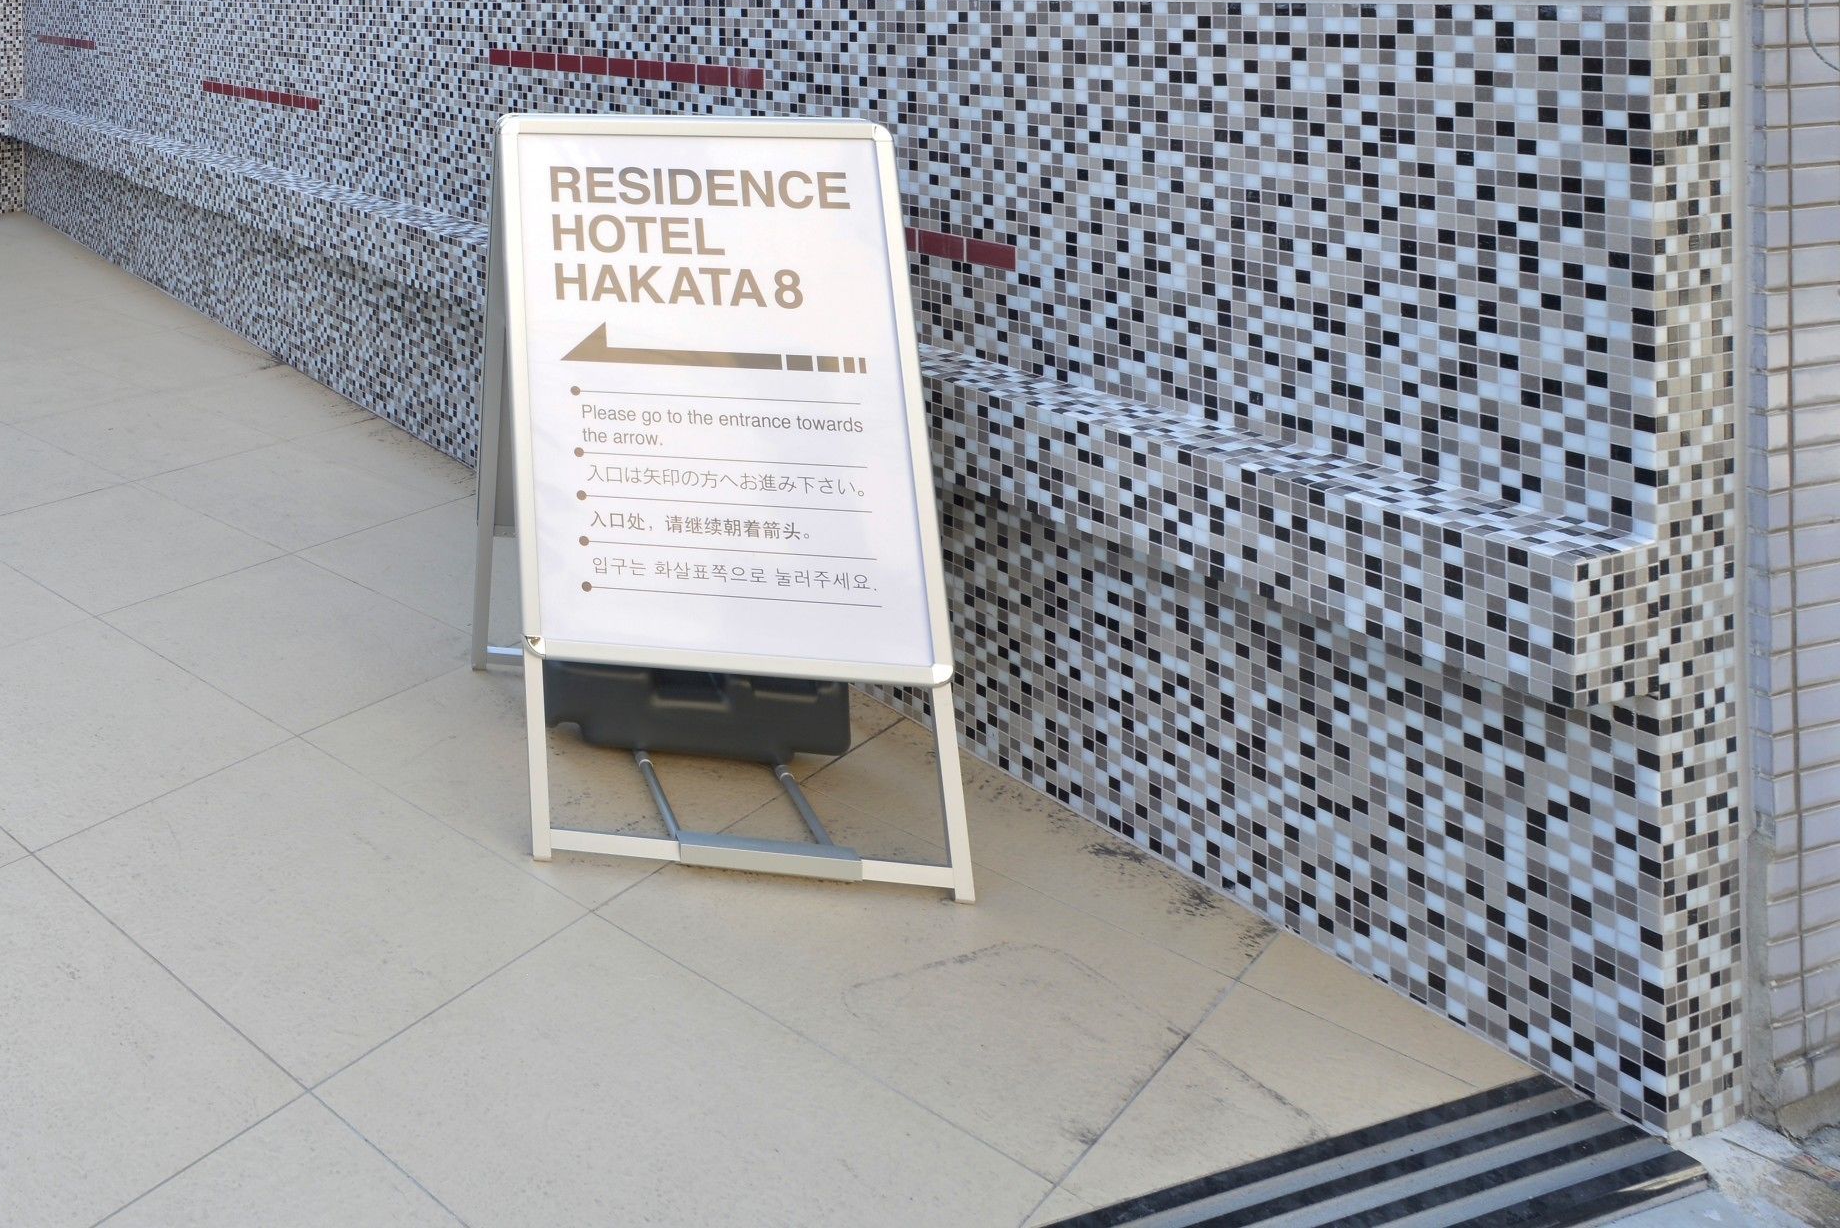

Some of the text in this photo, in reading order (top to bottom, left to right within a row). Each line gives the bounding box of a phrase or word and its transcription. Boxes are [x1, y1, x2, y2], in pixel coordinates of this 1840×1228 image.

[549, 165, 851, 211] RESIDENCE
[551, 213, 726, 257] HOTEL
[581, 404, 864, 433] Please go to the entrance towards
[582, 427, 664, 446] the arrow.
[586, 464, 866, 497] 入口は矢印の方へお進み下さい。
[592, 557, 878, 592] 입구는 화살표쪽으로 눌러주세요.
